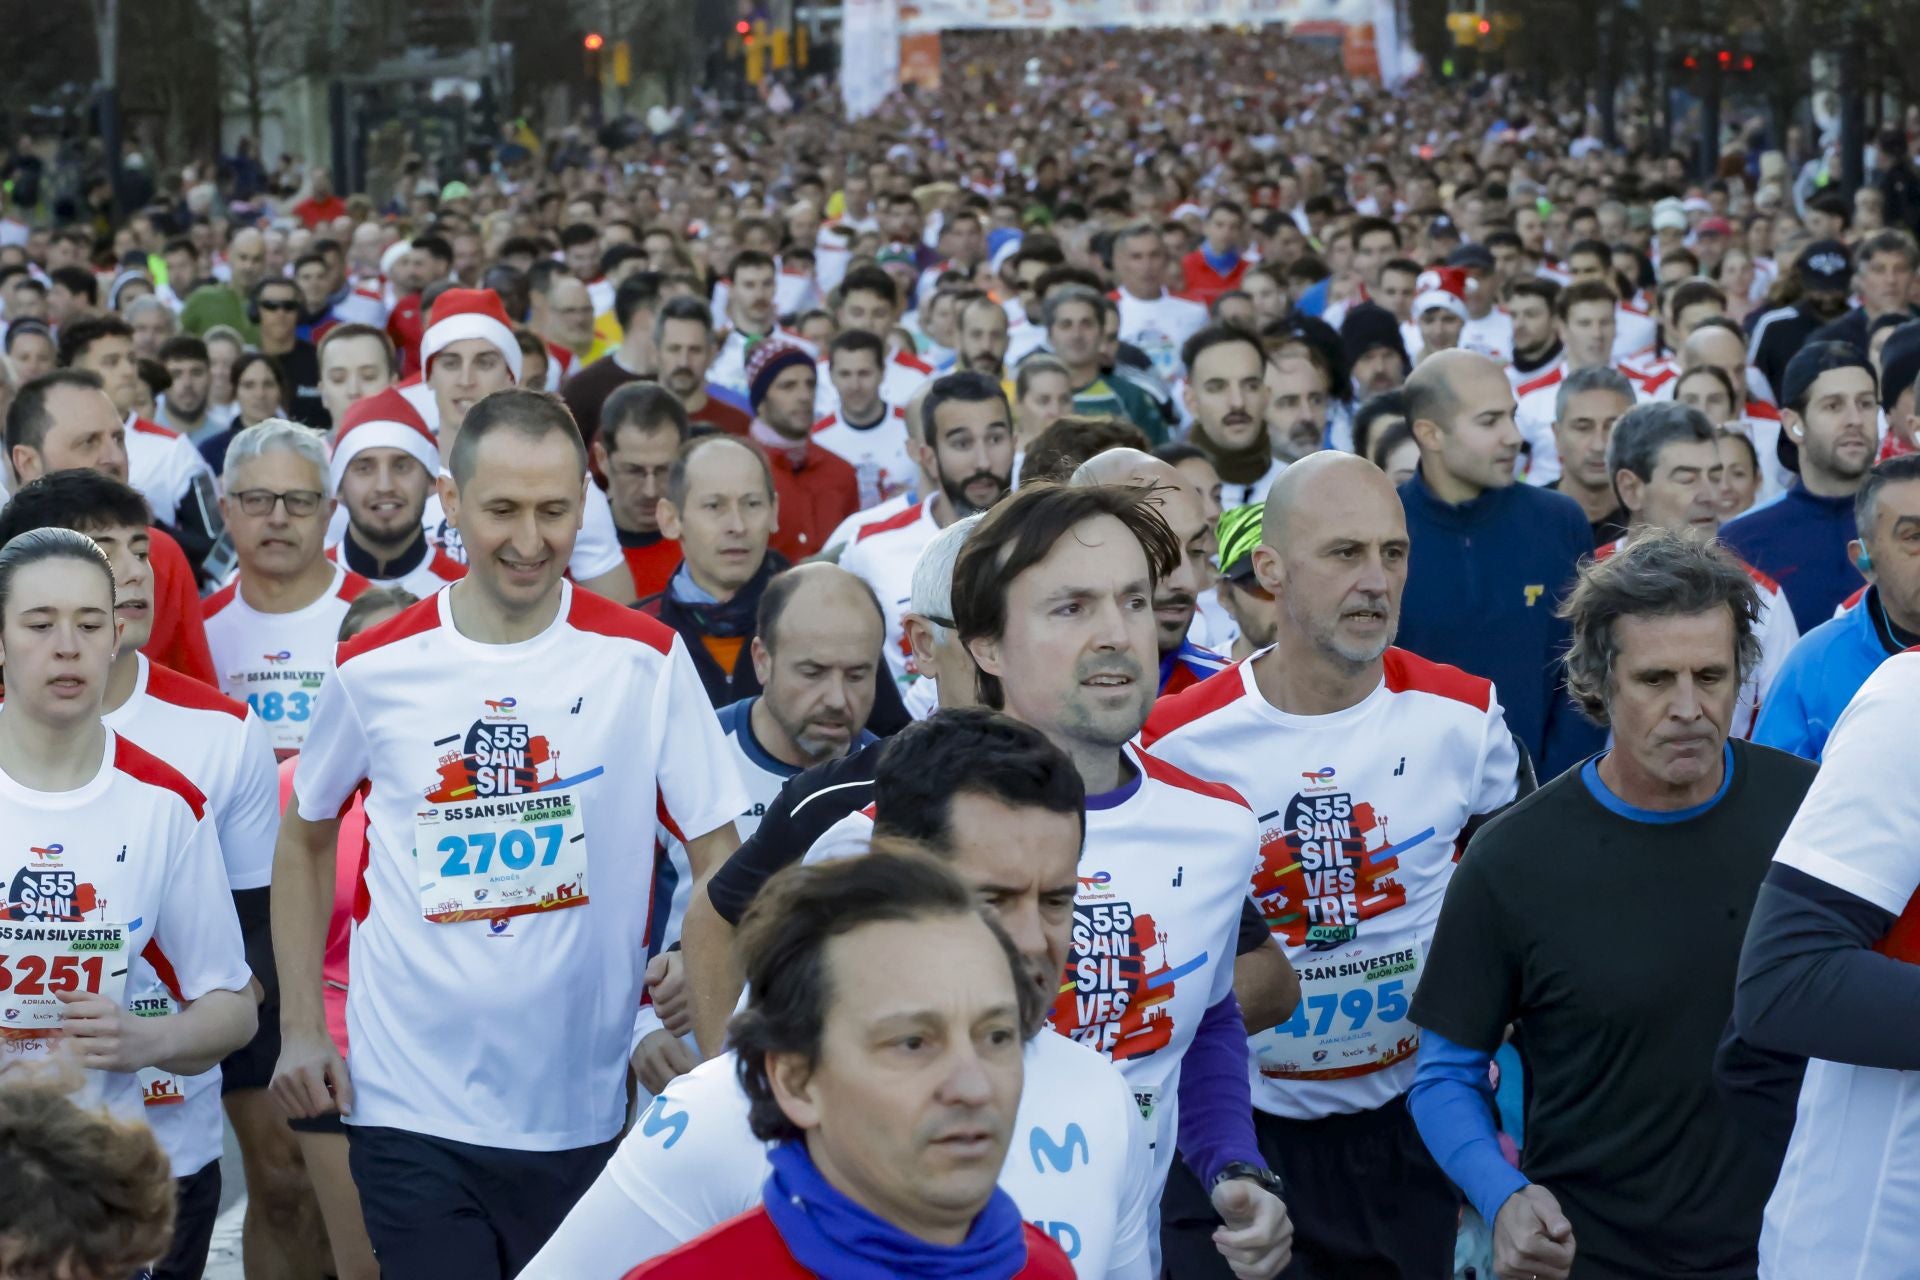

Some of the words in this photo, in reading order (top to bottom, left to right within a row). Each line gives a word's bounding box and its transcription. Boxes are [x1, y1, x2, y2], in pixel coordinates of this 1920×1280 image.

[260, 671, 280, 680] SAN
[493, 727, 528, 749] 55
[475, 739, 525, 768] SAN
[476, 766, 523, 794] SIL
[444, 808, 463, 821] 55
[465, 804, 495, 819] SAN
[497, 794, 571, 816] SILVESTRE
[1315, 795, 1350, 821] 55
[1296, 814, 1351, 841] SAN
[437, 823, 563, 877] 2707
[1301, 841, 1352, 870] SIL
[40, 873, 75, 896] 55
[1304, 867, 1356, 897] VES
[21, 887, 71, 917] SAN
[1302, 893, 1359, 926] TRE
[1092, 905, 1132, 932] 55
[14, 928, 45, 941] SAN
[47, 929, 121, 942] SILVESTRE
[99, 943, 119, 951] 2024
[1073, 924, 1130, 957] SAN
[1076, 957, 1128, 992] SIL
[1304, 966, 1337, 981] SAN
[1339, 948, 1413, 976] SILVESTRE
[1394, 963, 1414, 974] 2024
[1076, 991, 1129, 1026] VES
[1275, 979, 1408, 1038] 4795
